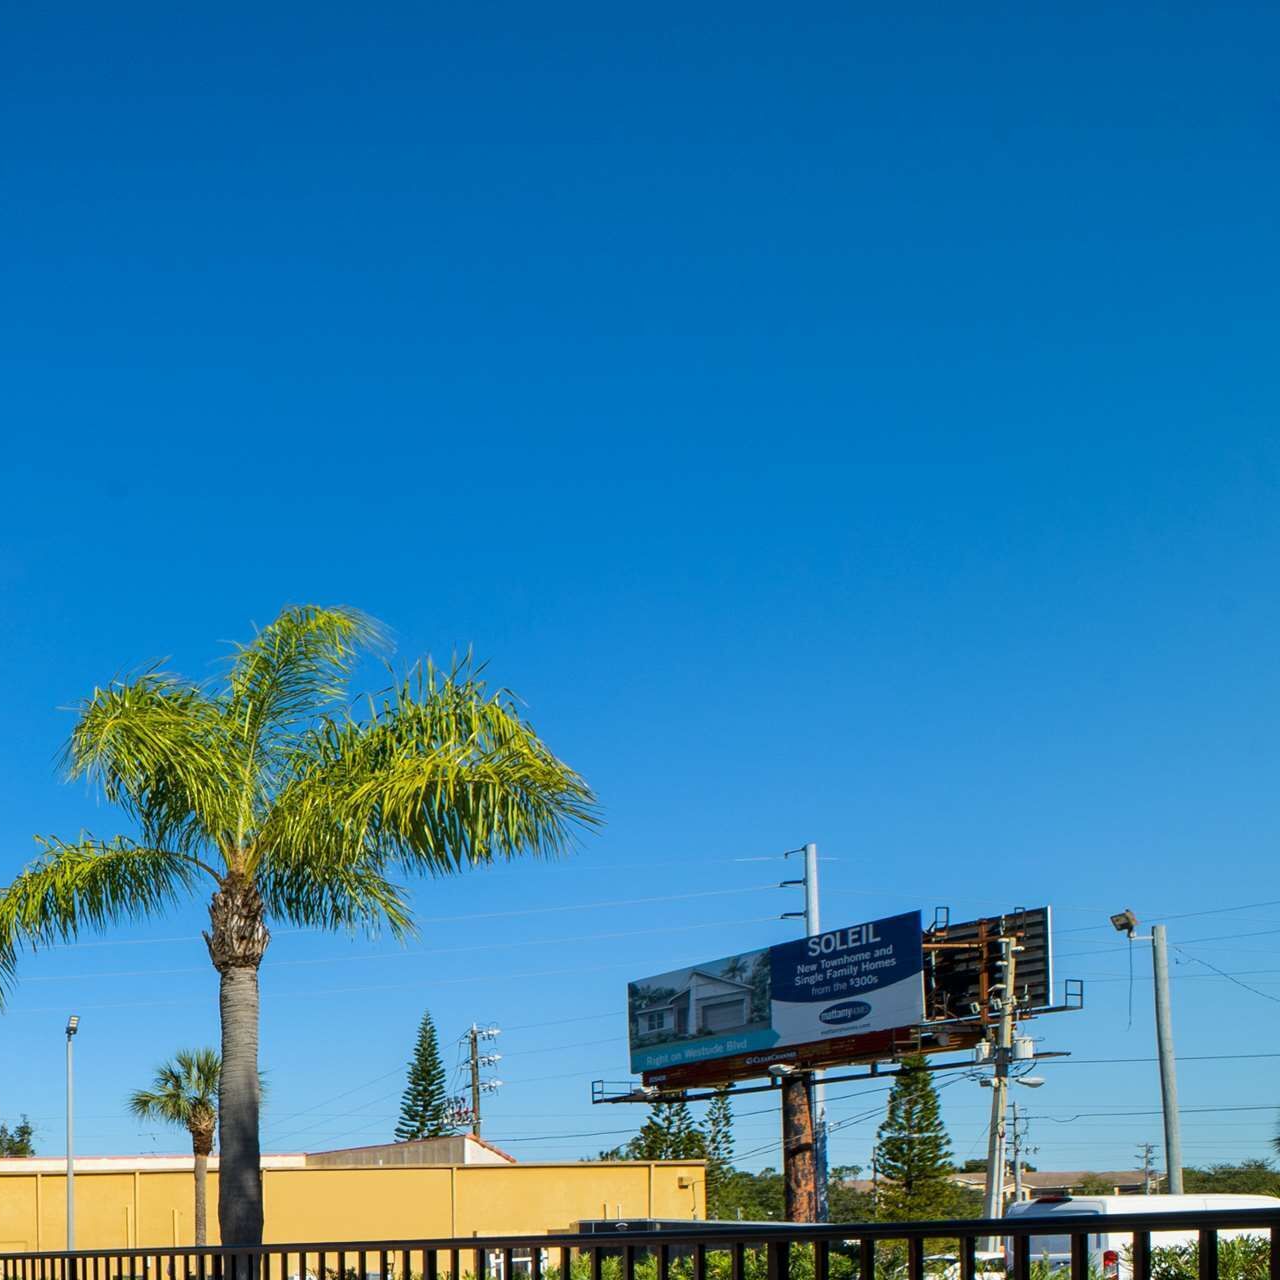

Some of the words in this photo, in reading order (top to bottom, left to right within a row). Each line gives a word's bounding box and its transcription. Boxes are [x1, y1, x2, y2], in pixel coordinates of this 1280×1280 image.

[808, 924, 881, 956] SOLEIL
[794, 972, 823, 986] Single
[826, 964, 858, 979] Family
[861, 957, 896, 971] Homes
[797, 963, 817, 974] New
[821, 950, 871, 969] Townhome
[874, 944, 893, 957] and
[811, 985, 831, 996] from
[833, 981, 848, 991] the
[849, 975, 878, 988] $300s
[646, 1054, 669, 1066] Right
[726, 1039, 747, 1050] Blvd
